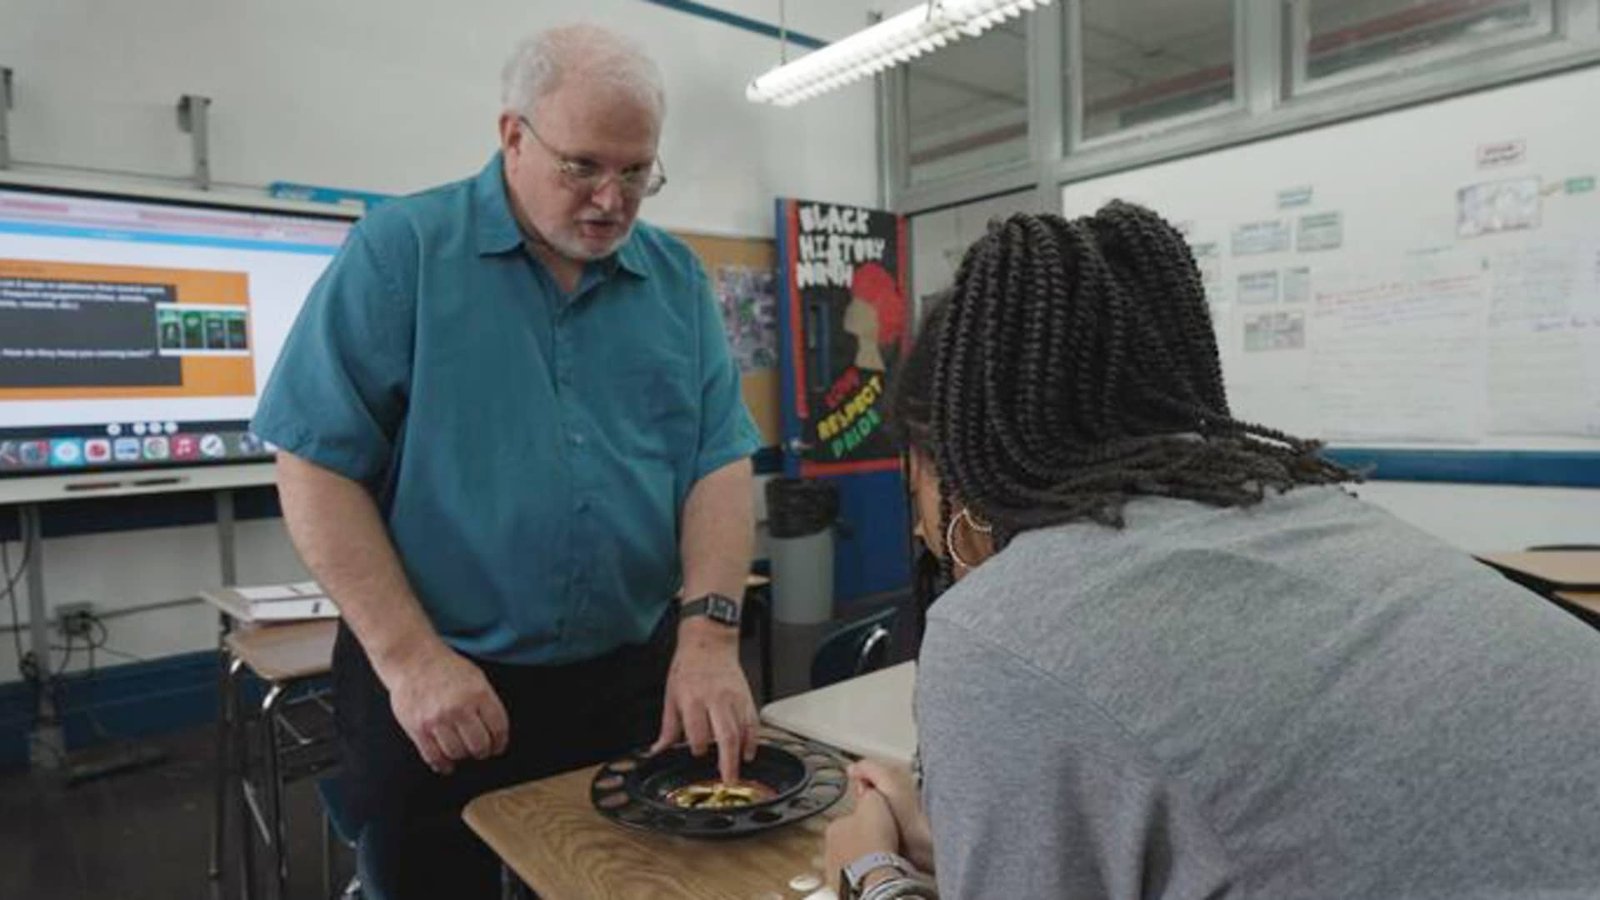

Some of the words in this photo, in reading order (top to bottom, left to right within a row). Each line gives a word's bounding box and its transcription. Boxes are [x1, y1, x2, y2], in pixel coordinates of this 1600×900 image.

[800, 204, 870, 235] BLACK
[799, 234, 885, 262] HISTORY
[817, 375, 883, 441] RESPECT
[831, 410, 881, 459] PRIDE
